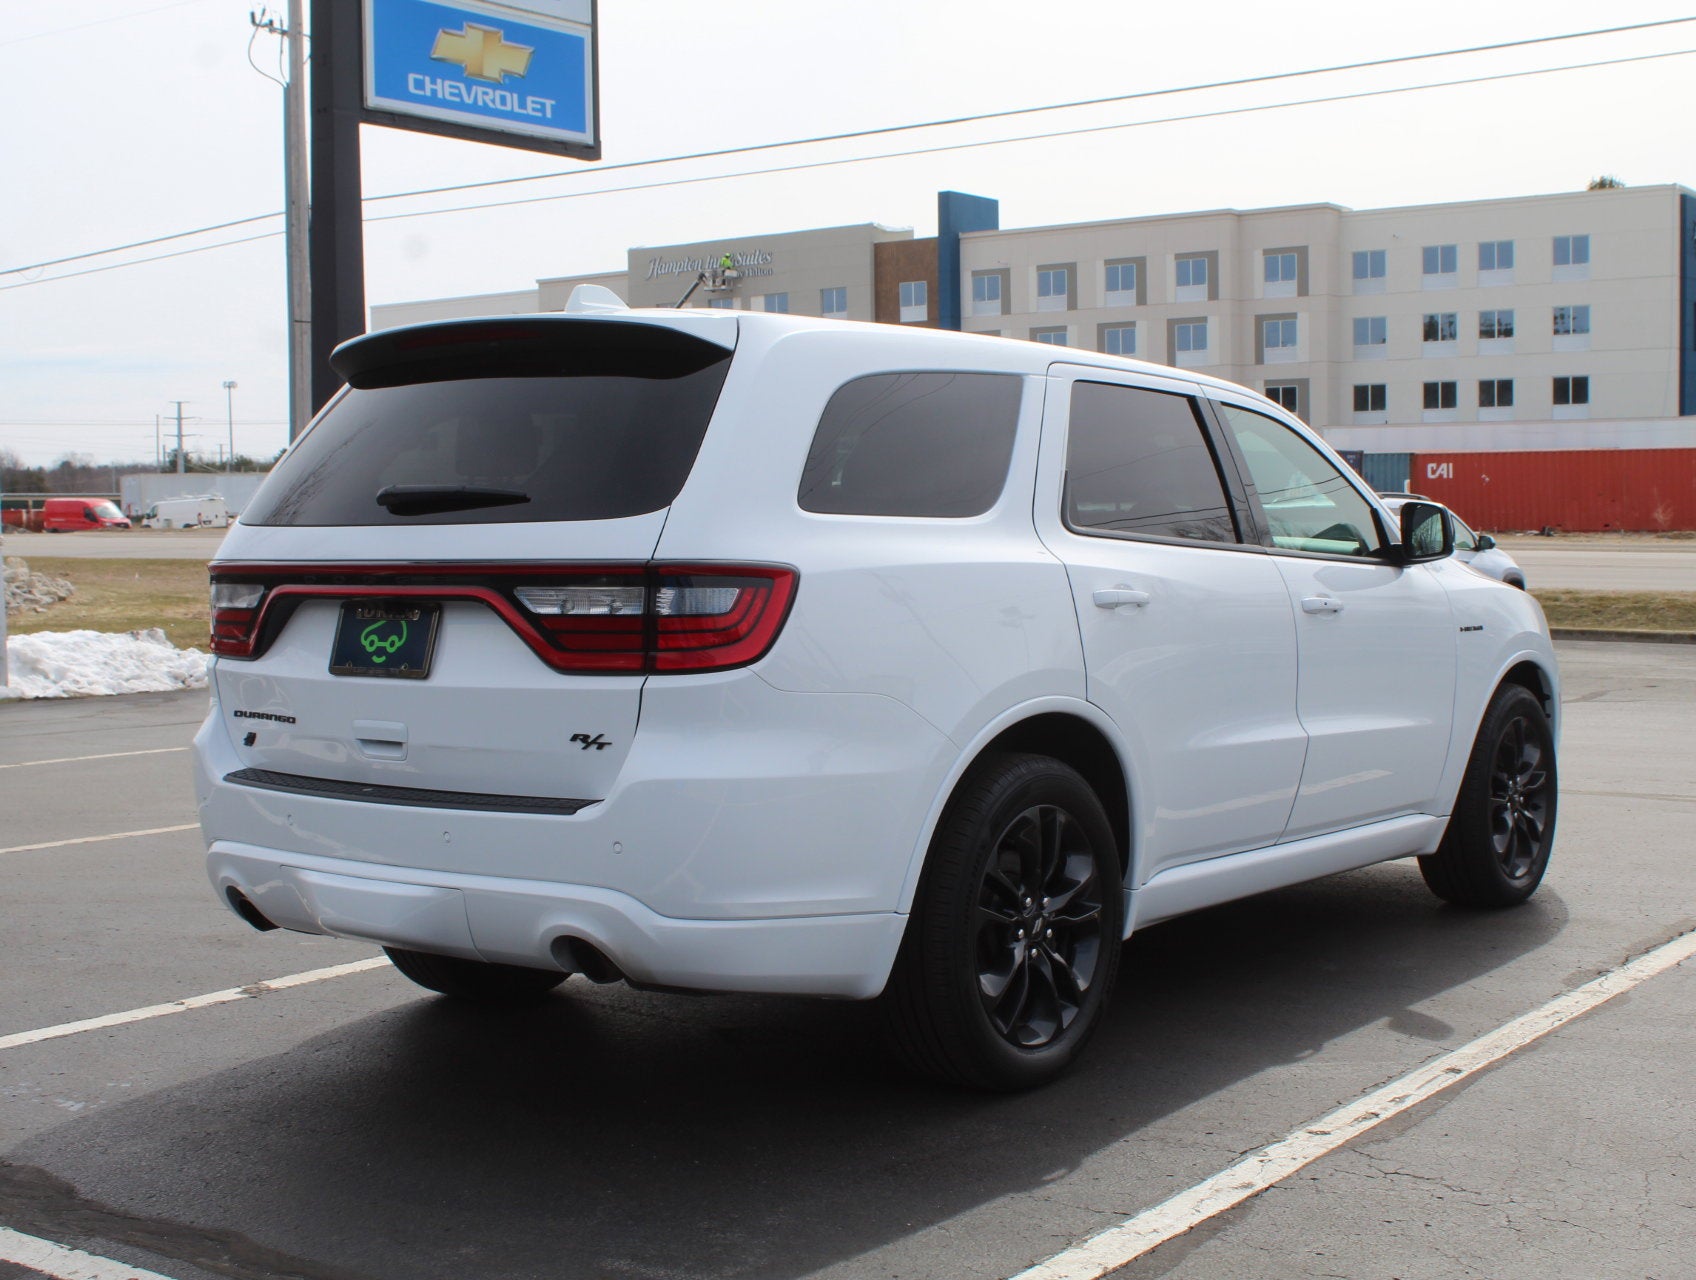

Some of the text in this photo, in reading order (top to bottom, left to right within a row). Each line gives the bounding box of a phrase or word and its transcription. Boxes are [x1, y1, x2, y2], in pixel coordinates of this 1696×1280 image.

[407, 73, 556, 118] CHEVROLET
[645, 256, 703, 281] Hampton
[1427, 462, 1454, 479] CAI
[233, 709, 297, 724] DURANGO
[569, 733, 613, 750] R/T
